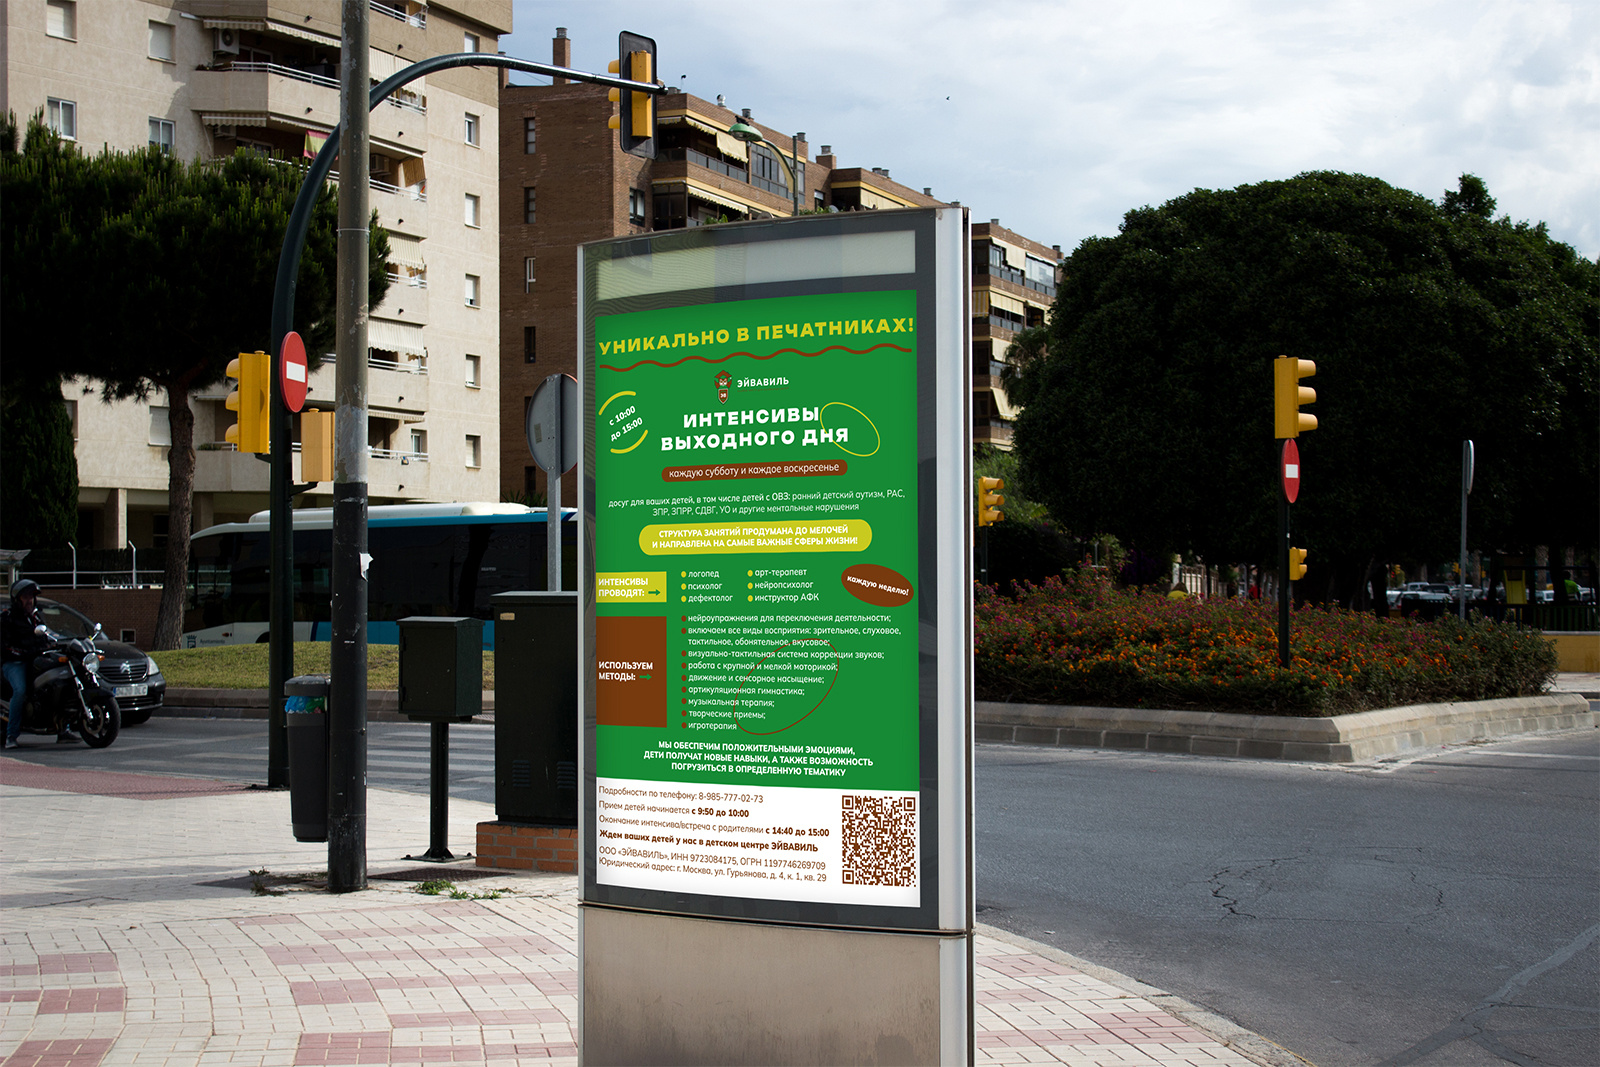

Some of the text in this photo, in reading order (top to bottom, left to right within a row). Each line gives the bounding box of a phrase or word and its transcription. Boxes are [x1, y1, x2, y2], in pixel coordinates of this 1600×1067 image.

[599, 318, 913, 355] УНИКАЛЬНО В ПЕЧАТНИКАХ!
[737, 377, 789, 387] ЭЙВАВИЛЬ
[615, 405, 635, 422] 10:00
[684, 407, 818, 428] ИНТЕНСИВЫ
[611, 417, 642, 442] до 15:00
[661, 428, 848, 451] ВЫХОДНОГО ДНЯ
[669, 470, 703, 479] каждую
[705, 466, 739, 478] субботу
[748, 466, 781, 474] каждое
[784, 464, 839, 474] воскресенье
[608, 500, 629, 508] досуг
[742, 494, 764, 502] детей
[792, 492, 821, 501] ранний
[822, 491, 853, 500] детский
[719, 505, 731, 513] УО
[739, 506, 765, 515] другие
[815, 504, 859, 512] нарушения
[659, 524, 848, 538] СТРУКТУРА ЗАНЯТИЙ ПРОДУМАНА ДО МЕЛОЧЕЙ
[660, 540, 712, 548] НАПРАВЛЕНА
[757, 538, 792, 546] ВАЖНЫЕ
[755, 569, 807, 578] арт-терапевт
[755, 581, 813, 590] нейропсихолог
[847, 576, 909, 596] каждую неделю!
[599, 589, 644, 598] ПРОВОДЯТ:
[688, 594, 733, 603] дефектолог
[755, 593, 819, 603] инструктор АФК
[688, 614, 758, 623] нейроупражнения
[776, 615, 833, 623] переключения
[765, 628, 811, 636] восприятия:
[813, 628, 860, 636] зрительное,
[862, 628, 901, 636] слуховое,
[735, 638, 790, 646] обонятельное,
[792, 639, 830, 648] вкусовое;
[688, 651, 775, 659] визуально-тактильная
[811, 652, 853, 660] коррекции
[855, 652, 884, 660] звуков;
[599, 661, 653, 669] ИСПОЛЬЗУЕМ
[688, 662, 715, 670] работа
[723, 662, 755, 671] крупной
[794, 663, 838, 672] моторикой;
[599, 672, 635, 682] МЕТОДЫ:
[735, 675, 775, 684] сенсорное
[688, 687, 756, 695] артикуляционная
[689, 699, 774, 708] музыкальная терапия;
[689, 711, 765, 720] творческие приемы;
[689, 723, 737, 731] игротерапия
[674, 742, 720, 750] ОБЕСПЕЧИМ
[722, 743, 803, 753] ПОЛОЖИТЕЛЬНЫМИ
[806, 746, 855, 755] ЭМОЦИЯМИ,
[644, 751, 664, 759] ДЕТИ
[666, 752, 702, 760] ПОЛУЧАТ
[704, 753, 732, 761] НОВЫЕ
[734, 755, 770, 763] НАВЫКИ,
[780, 756, 807, 764] ТАКЖЕ
[810, 757, 873, 766] ВОЗМОЖНОСТЬ
[672, 762, 726, 772] ПОГРУЗИТЬСЯ
[735, 765, 802, 775] ОПРЕДЕЛЕННУЮ
[804, 768, 846, 776] ТЕМАТИКУ
[599, 786, 647, 796] Подробности
[659, 791, 697, 801] телефону:
[699, 792, 763, 803] 8-985-777-02-73
[599, 801, 622, 810] Прием
[647, 806, 689, 814] начинается
[698, 807, 714, 815] 9:50
[729, 809, 749, 817] 10:00
[599, 815, 639, 825] Окончание
[641, 821, 710, 831] интенсива/встреча
[719, 825, 763, 833] родителями
[772, 827, 793, 835] 14:40
[808, 828, 829, 837] 15:00
[600, 829, 622, 839] Ждем
[741, 842, 769, 850] центре
[771, 841, 818, 852] ЭЙВАВИЛЬ
[599, 846, 616, 855] ООО
[671, 853, 688, 861] ИНН
[690, 854, 738, 865] 9723084175,
[740, 857, 761, 866] ОГРН
[765, 859, 826, 870] 1197746269709
[599, 857, 826, 882] Юридический адрес: Москва, Гурьянова, 29
